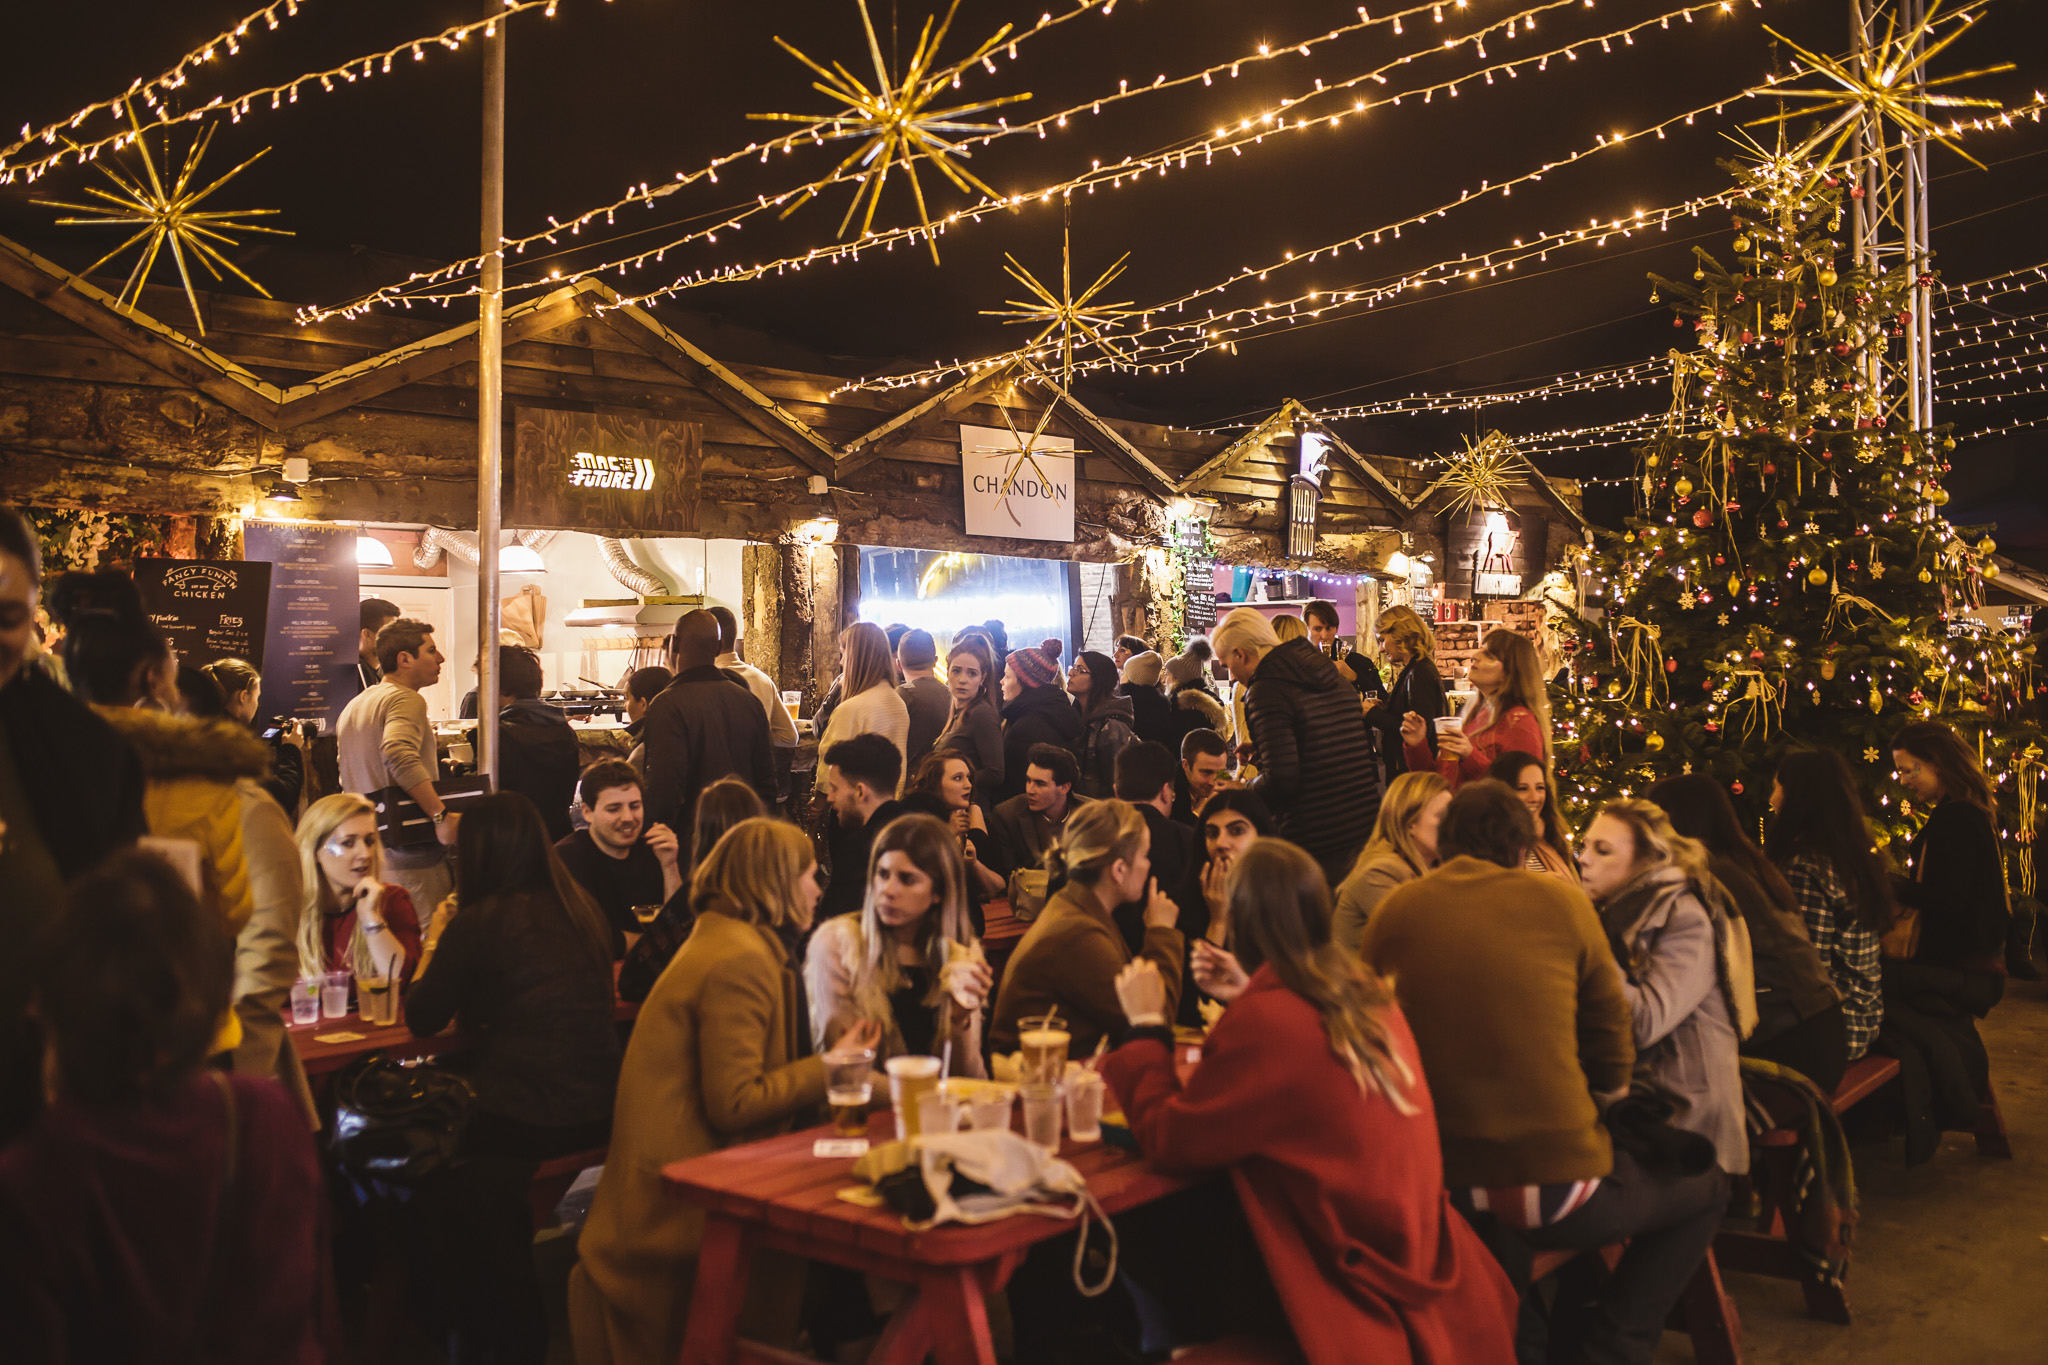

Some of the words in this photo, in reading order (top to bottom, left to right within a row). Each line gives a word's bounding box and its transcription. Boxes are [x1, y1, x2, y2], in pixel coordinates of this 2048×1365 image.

[571, 469, 635, 490] FUTURE
[973, 474, 1067, 500] CHANDON
[1292, 488, 1316, 523] VUDU
[1290, 522, 1314, 557] FOOD
[162, 568, 196, 587] FANCY
[201, 568, 238, 590] FUNKIN
[173, 590, 225, 599] CHICKEN
[219, 614, 243, 627] FRIES
